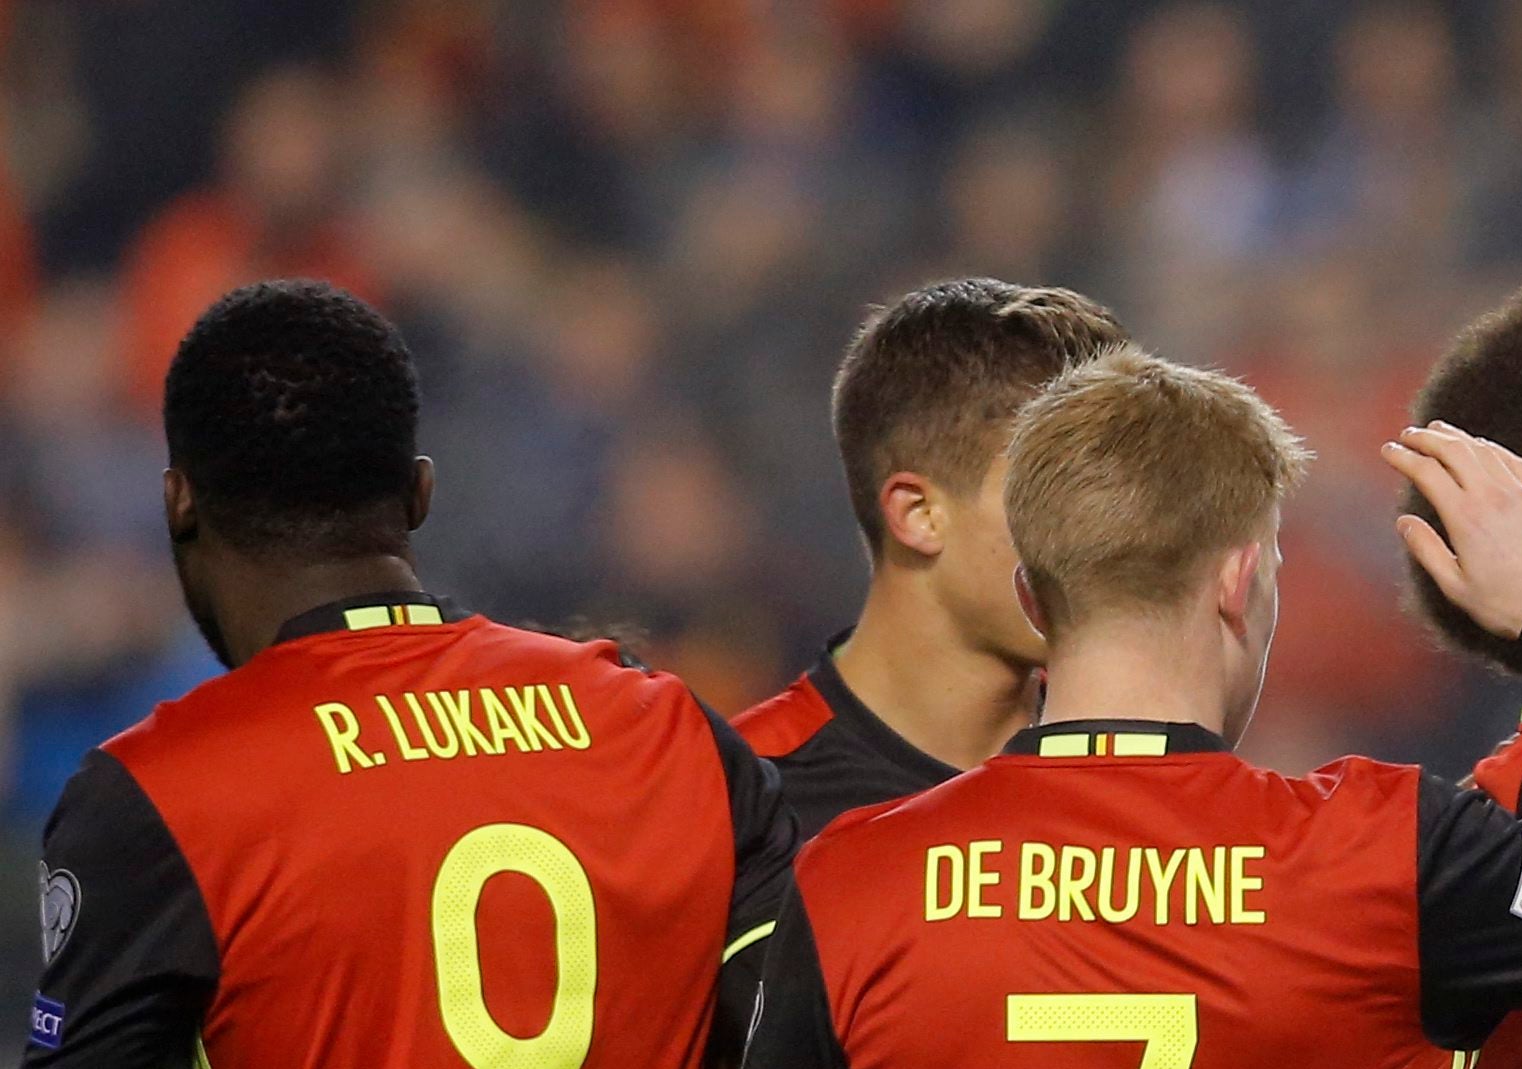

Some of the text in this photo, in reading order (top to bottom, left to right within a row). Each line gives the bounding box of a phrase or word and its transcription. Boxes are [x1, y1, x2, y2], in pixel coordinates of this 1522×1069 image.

[315, 684, 591, 774] R. LUKAKU
[925, 840, 1266, 925] DE BRUYNE
